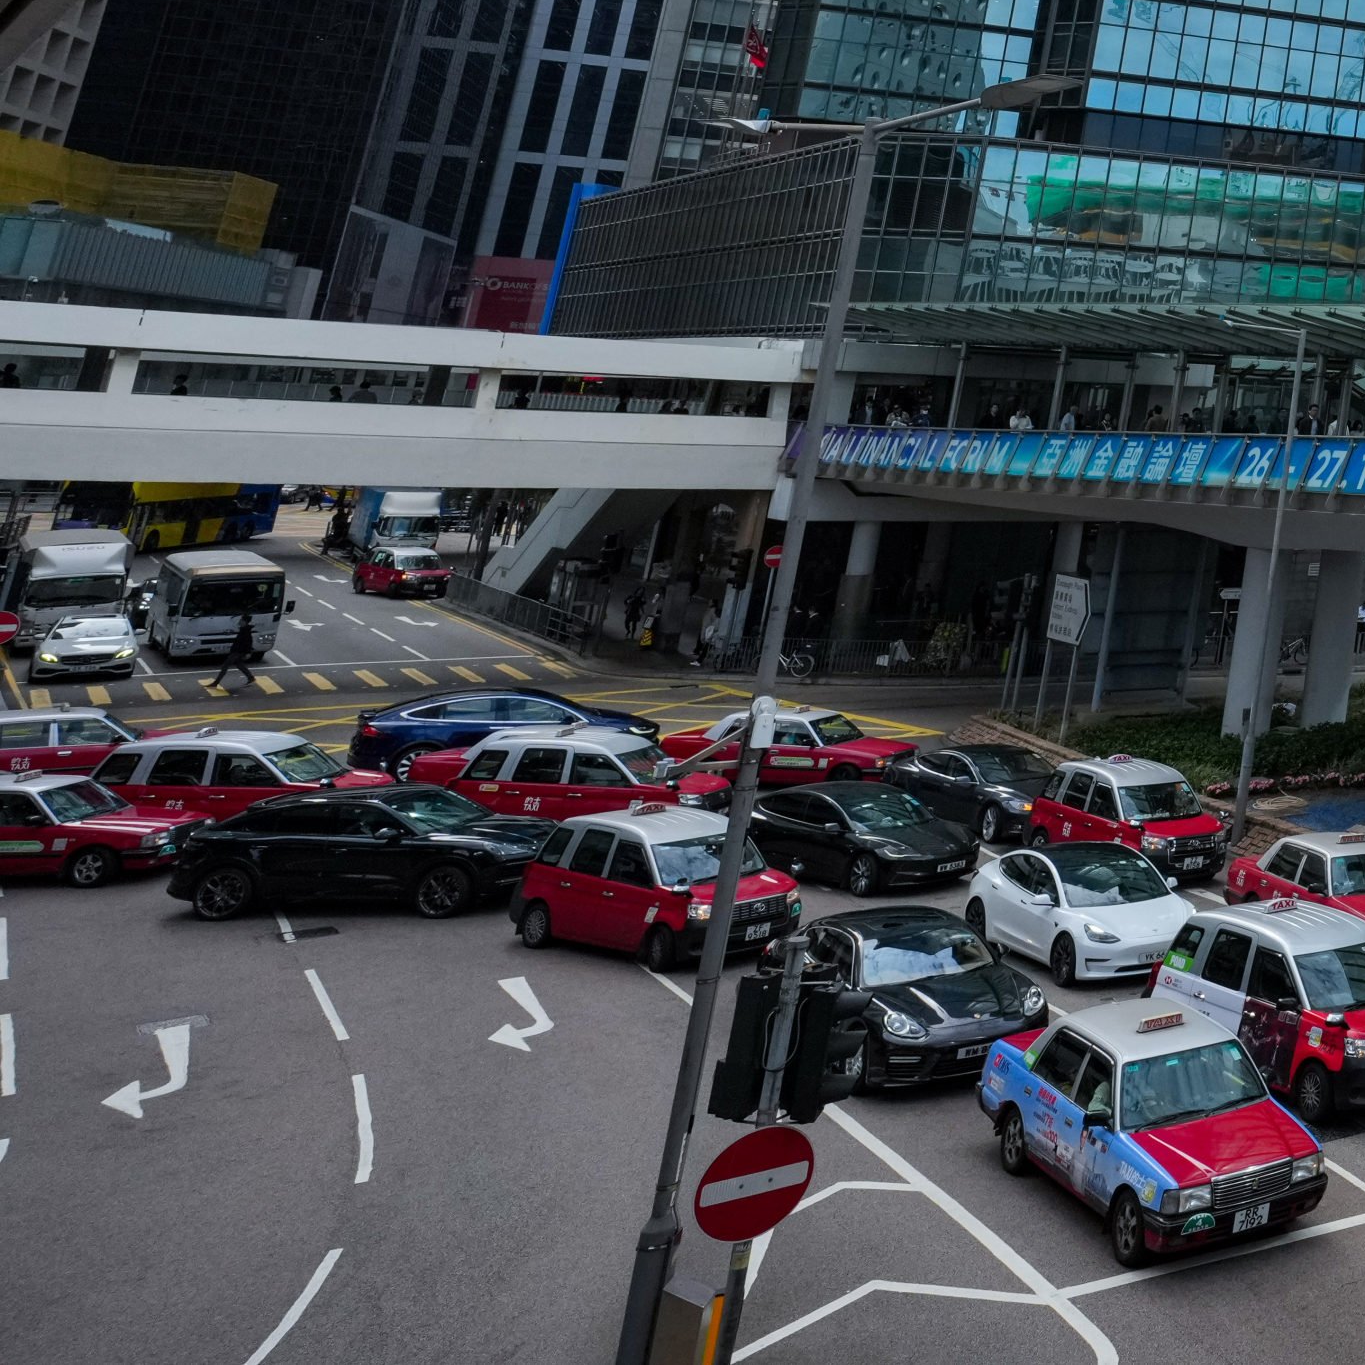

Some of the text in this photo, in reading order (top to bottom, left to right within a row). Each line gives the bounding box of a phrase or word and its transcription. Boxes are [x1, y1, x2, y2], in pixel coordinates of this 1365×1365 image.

[502, 281, 530, 291] BANK
[944, 439, 1009, 472] FORUM
[1038, 438, 1207, 483] 亞洲金融論壇
[1236, 446, 1272, 484] 26
[62, 544, 105, 552] ISUZU
[1114, 754, 1131, 762] TAXI
[1272, 900, 1296, 910] TAXI
[1145, 953, 1155, 961] YK
[1147, 1014, 1183, 1029] TAXI
[1245, 1208, 1259, 1220] RR
[1239, 1216, 1264, 1232] 7192
